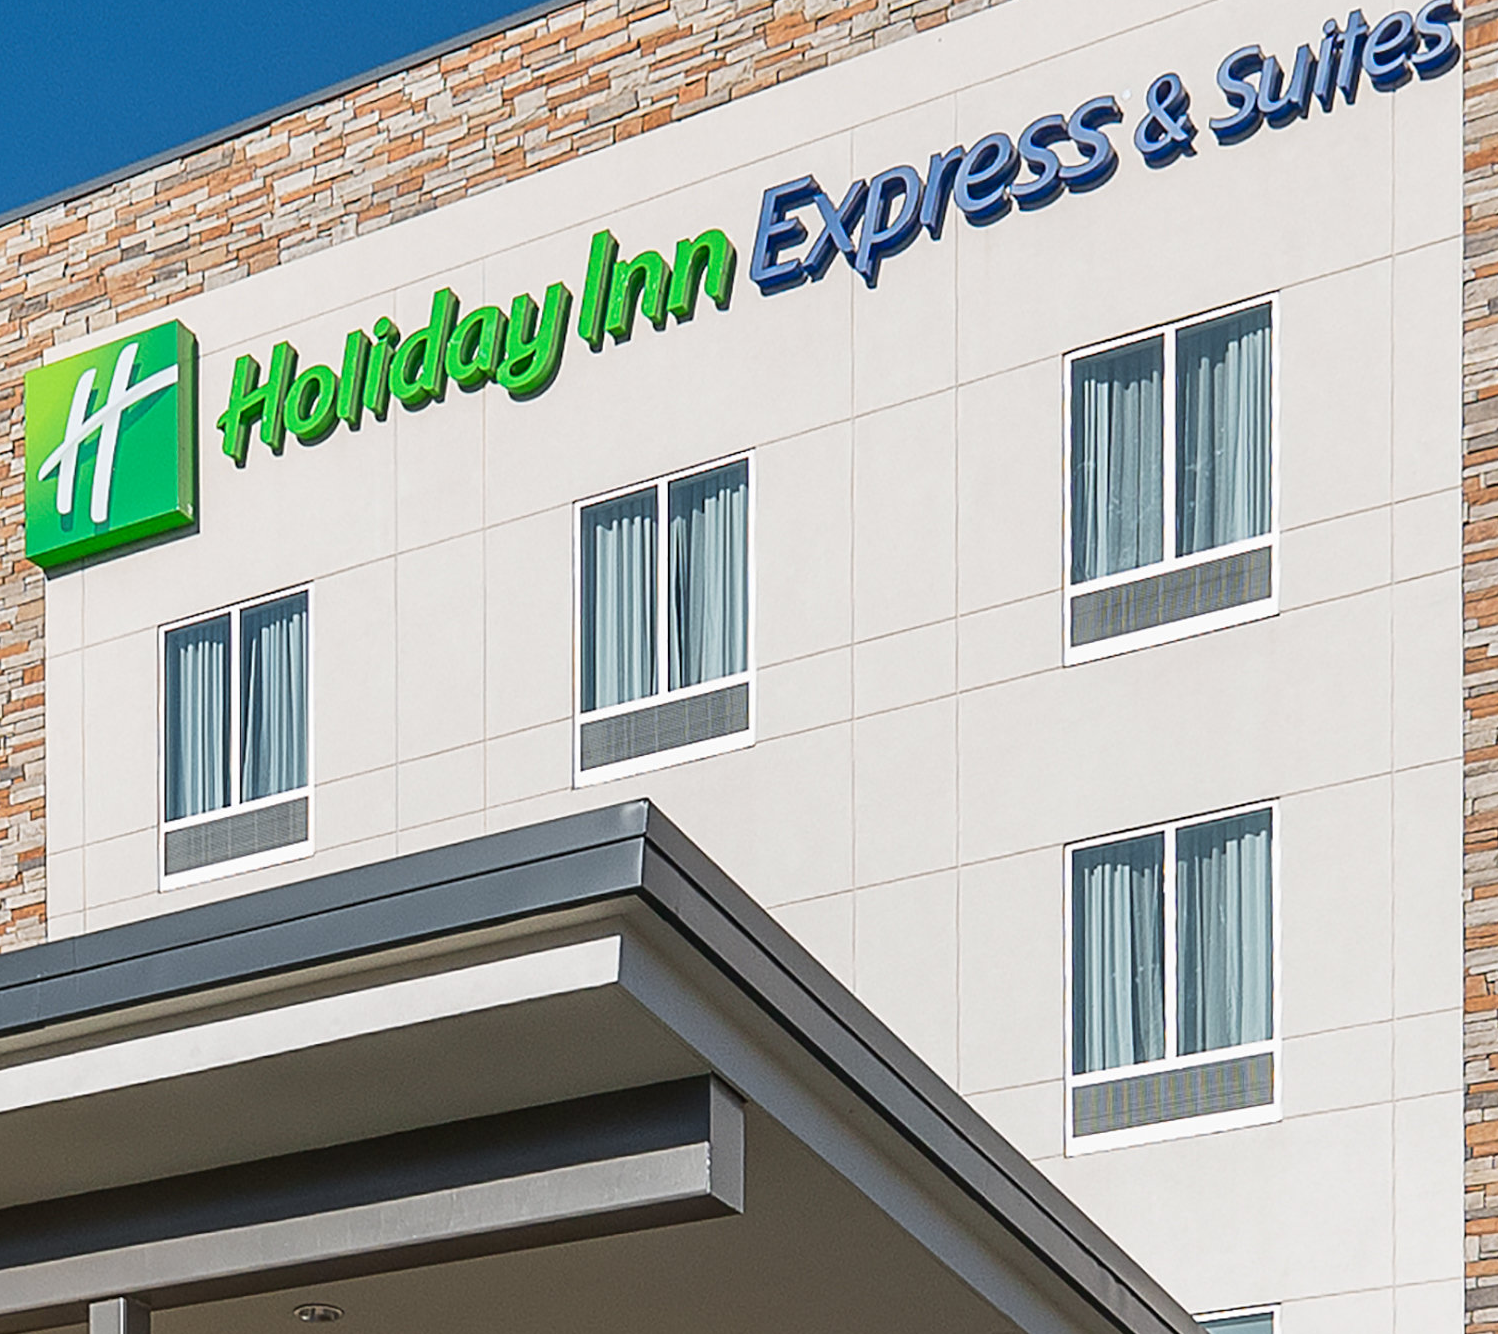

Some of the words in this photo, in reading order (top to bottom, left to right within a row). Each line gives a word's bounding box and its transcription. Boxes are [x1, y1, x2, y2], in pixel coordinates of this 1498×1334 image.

[217, 282, 572, 467] Holiday
[578, 229, 736, 352] Inn
[750, 96, 1123, 295] Express
[1134, 73, 1198, 169] &
